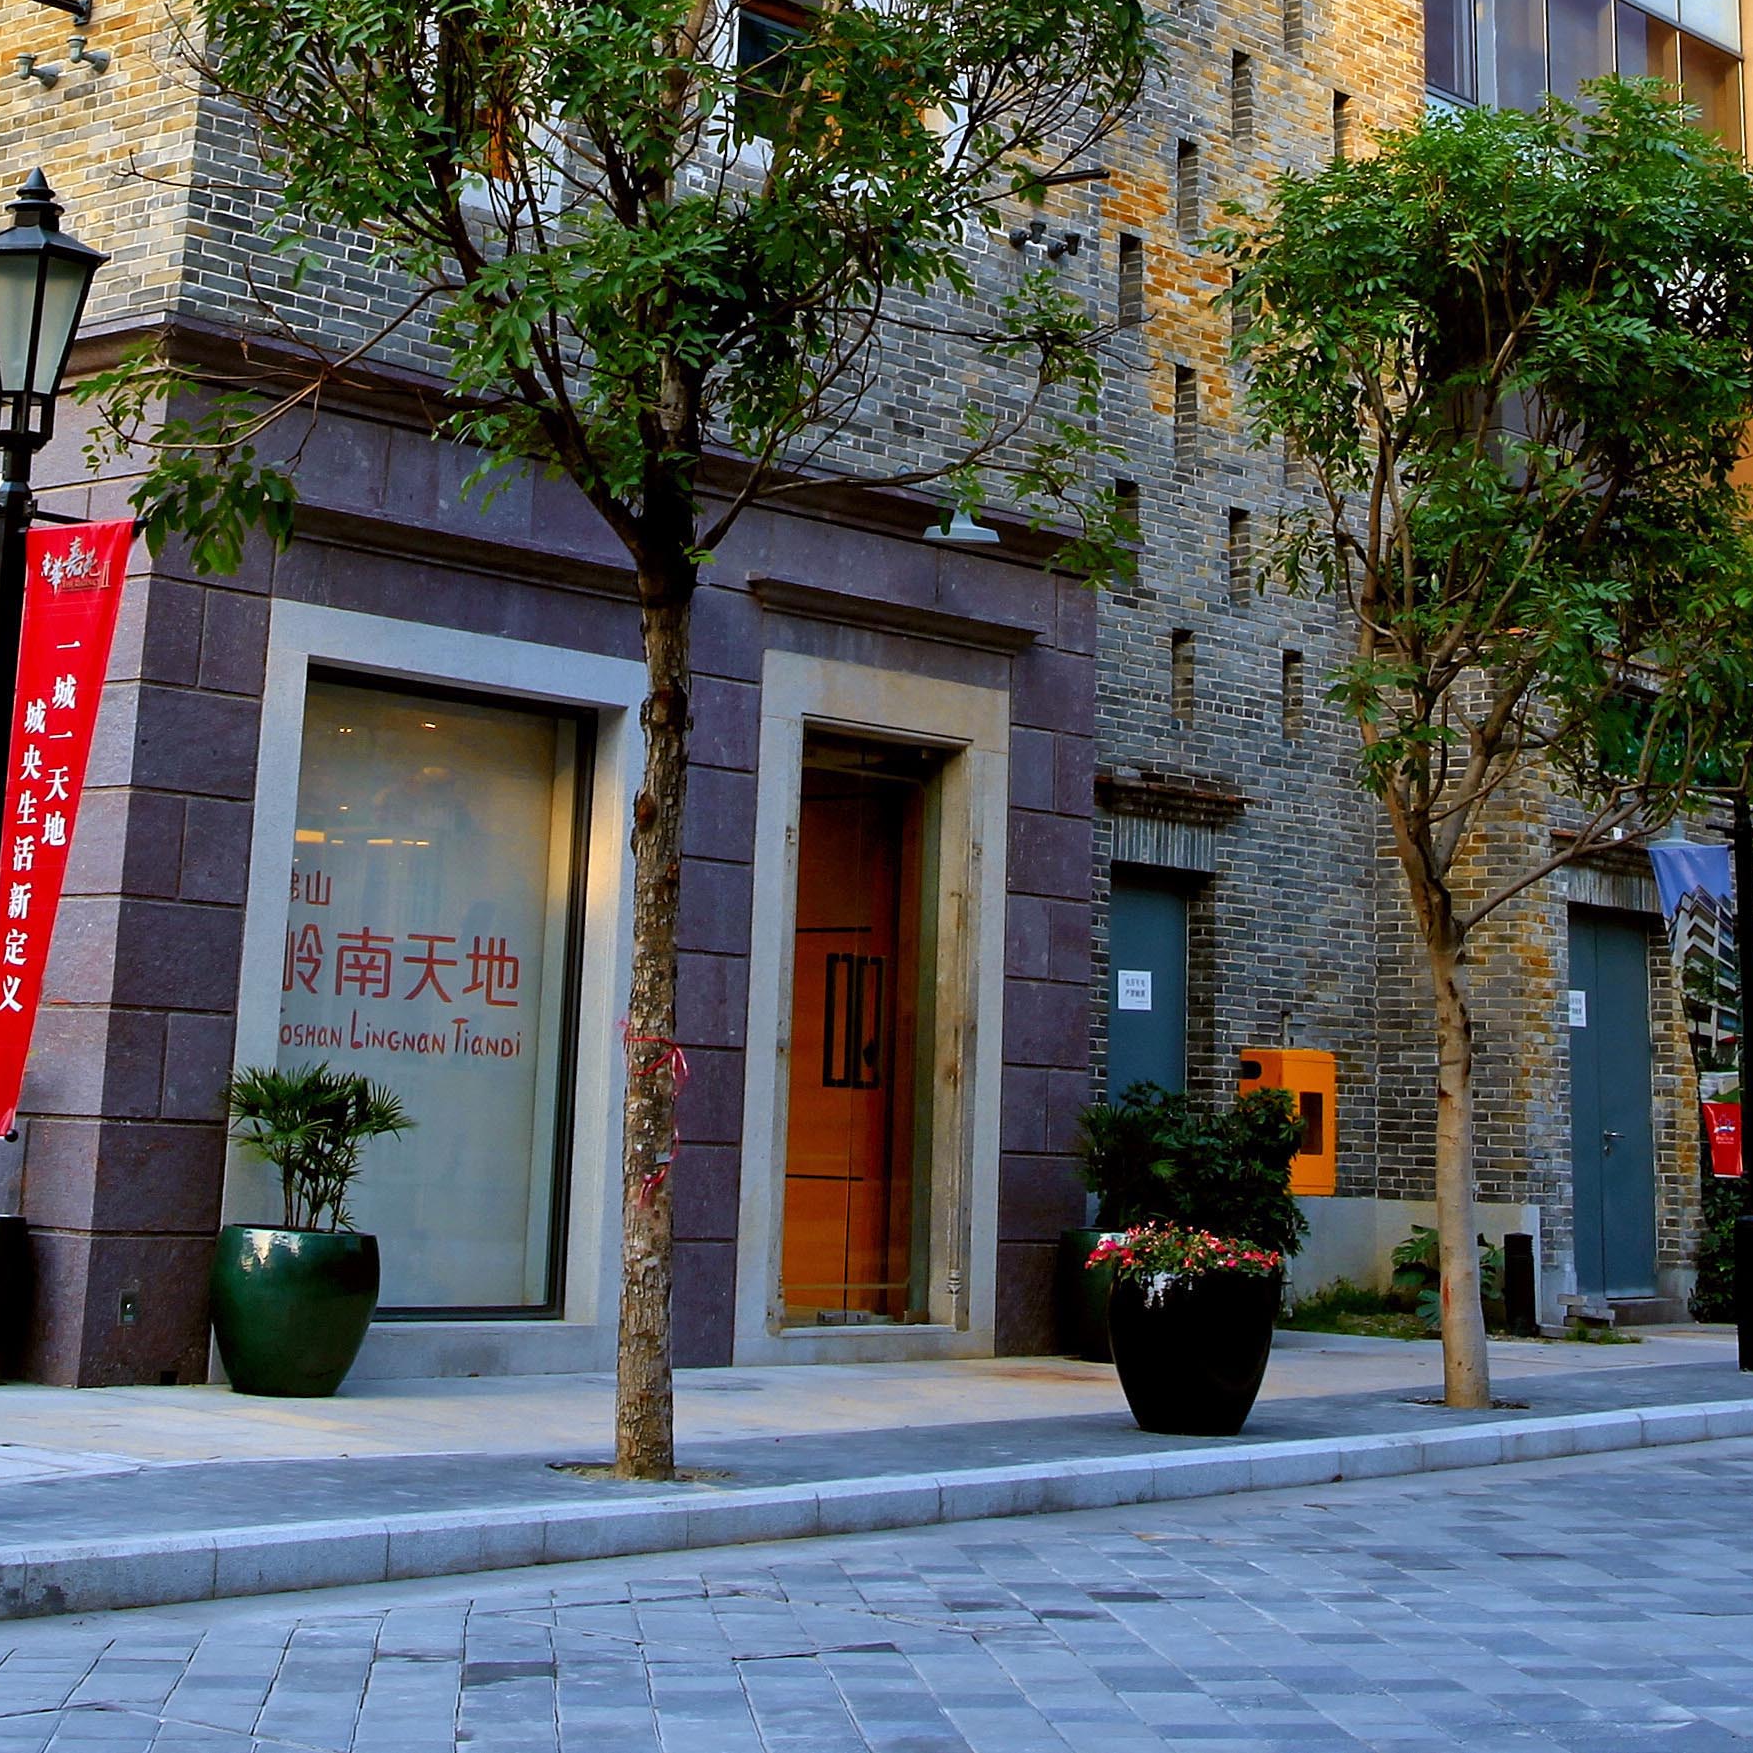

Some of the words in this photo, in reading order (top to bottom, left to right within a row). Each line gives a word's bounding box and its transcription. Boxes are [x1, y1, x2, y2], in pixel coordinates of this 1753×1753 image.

[42, 640, 81, 848] 一城一天地
[281, 921, 519, 1007] 岭南天地
